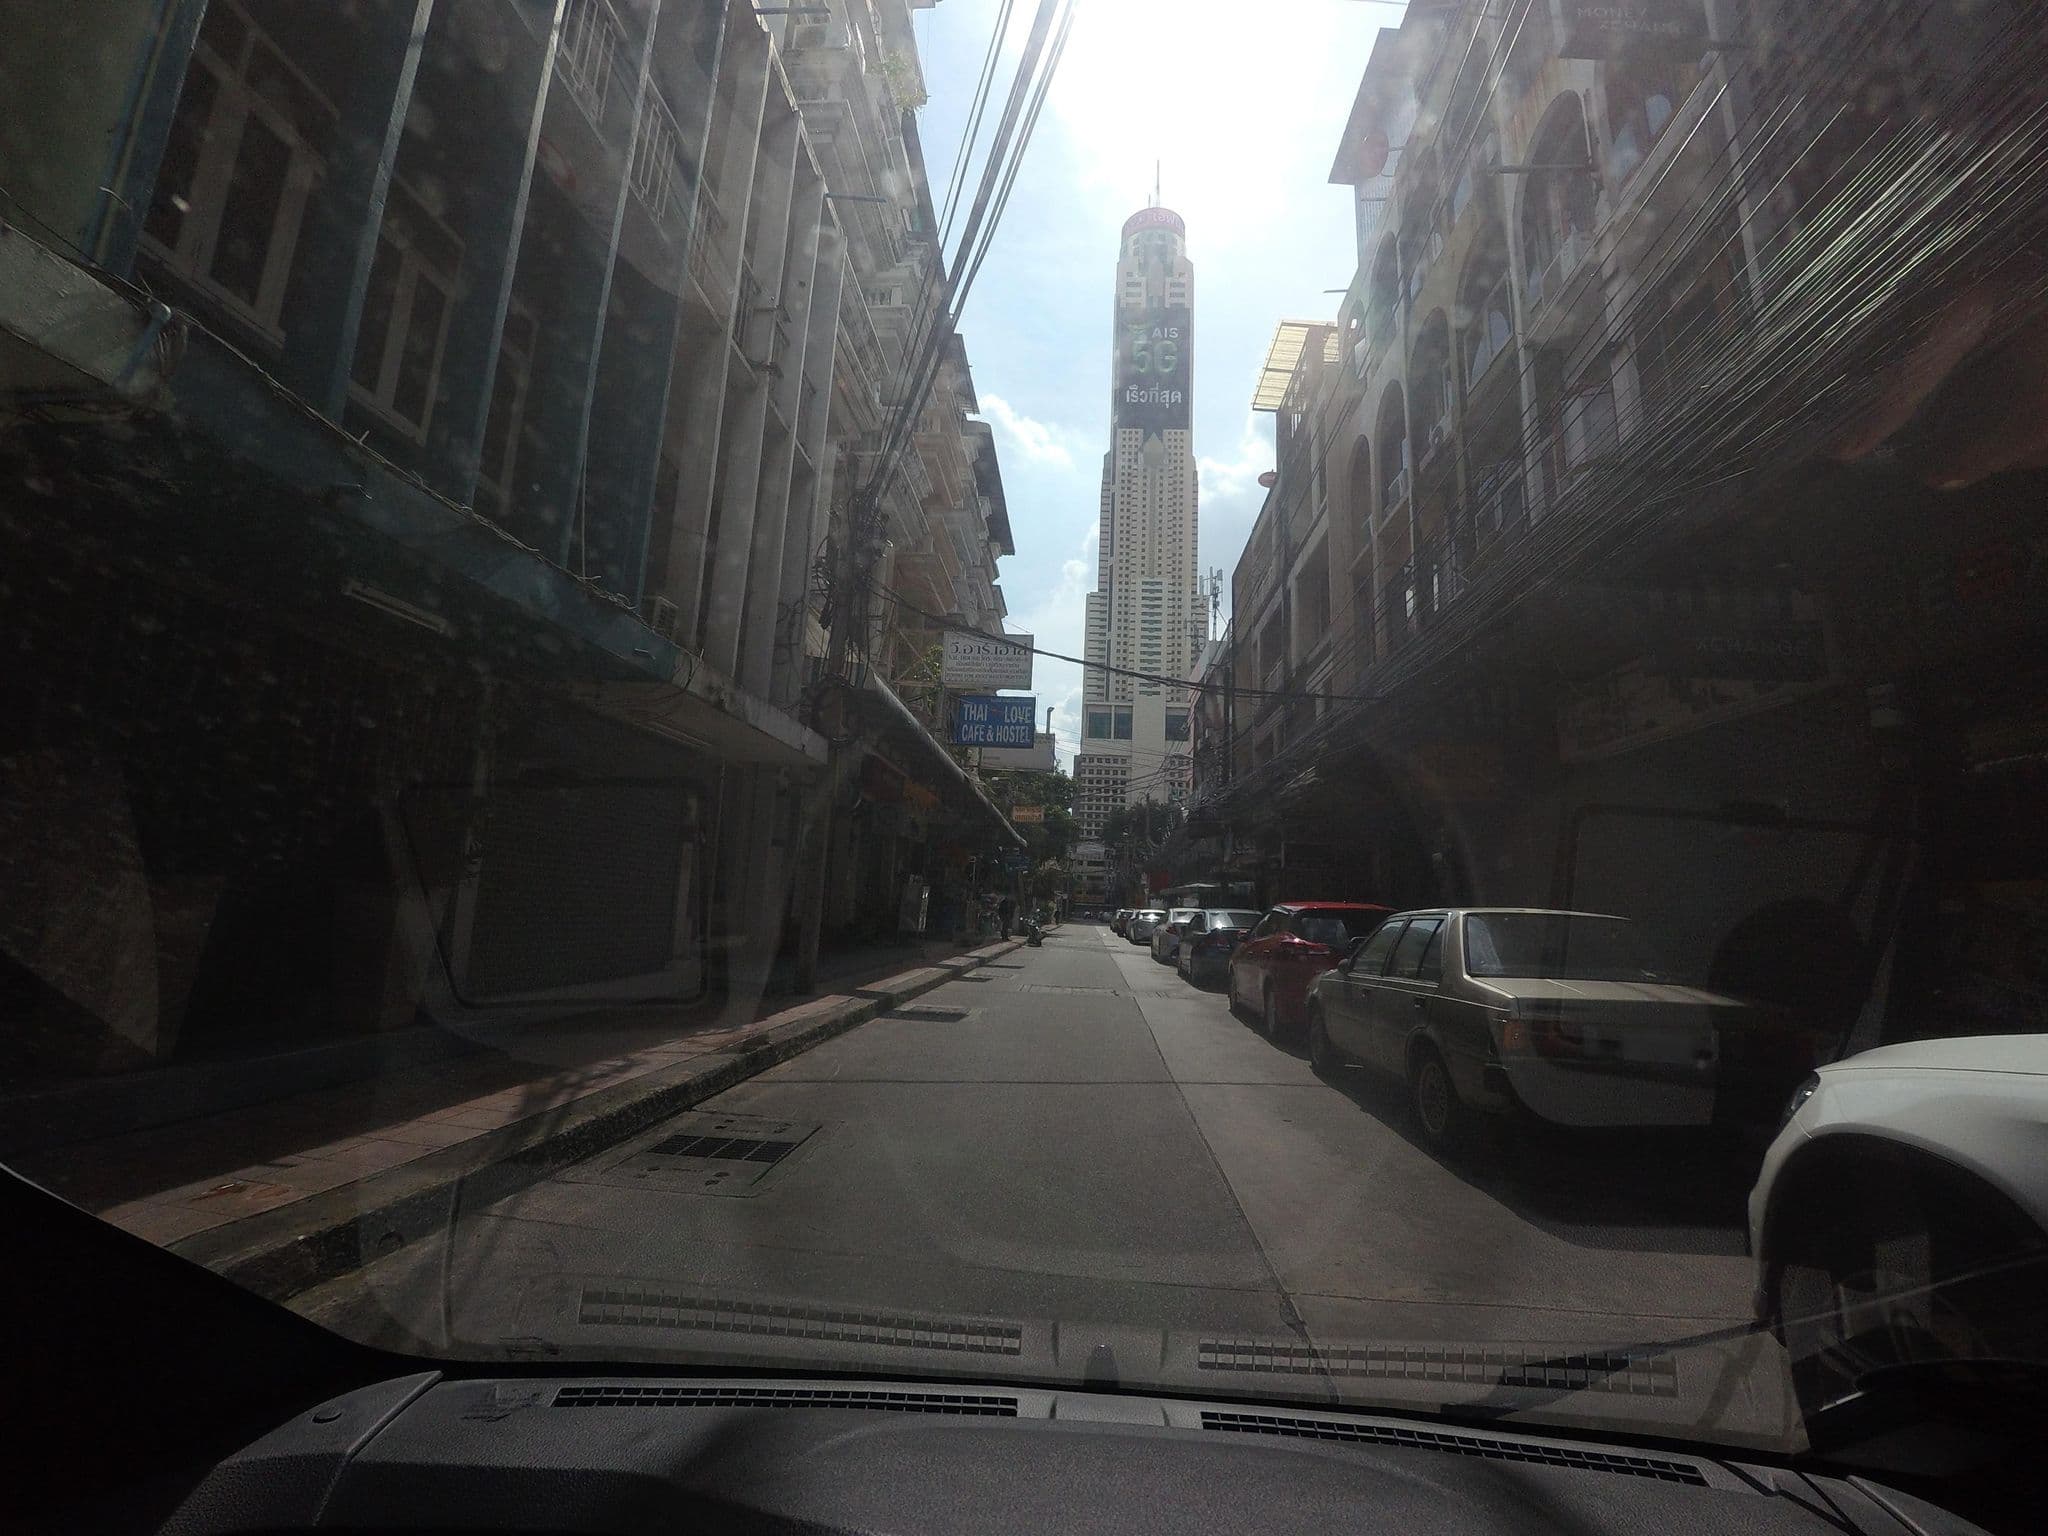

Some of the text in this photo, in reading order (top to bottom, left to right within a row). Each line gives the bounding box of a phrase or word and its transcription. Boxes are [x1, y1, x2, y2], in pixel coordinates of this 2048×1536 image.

[1152, 327, 1179, 339] AIS
[1132, 340, 1178, 373] 5G
[963, 704, 1032, 724] THAI LOVE
[961, 724, 1031, 743] CAFE & HOSTEL
